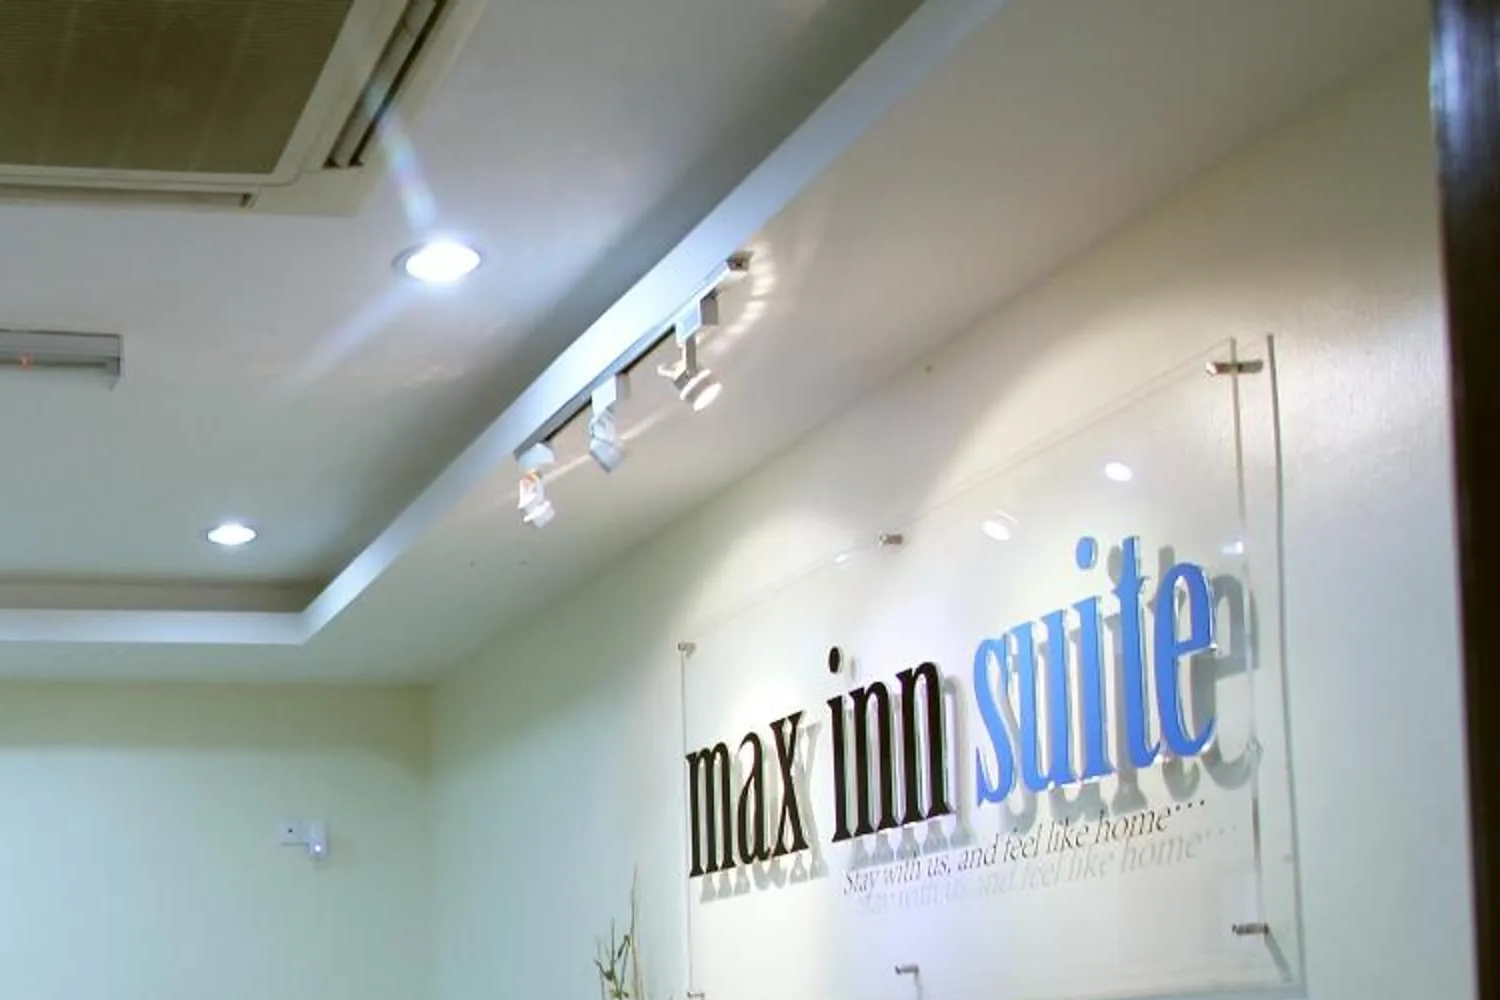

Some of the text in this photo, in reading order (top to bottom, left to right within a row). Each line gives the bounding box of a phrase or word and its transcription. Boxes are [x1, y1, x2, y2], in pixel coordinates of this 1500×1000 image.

[685, 535, 1219, 878] max inn suite
[843, 866, 884, 896] Stay
[882, 855, 922, 890] with
[956, 830, 999, 870] and
[1001, 825, 1042, 864] feel
[1045, 819, 1090, 856] like
